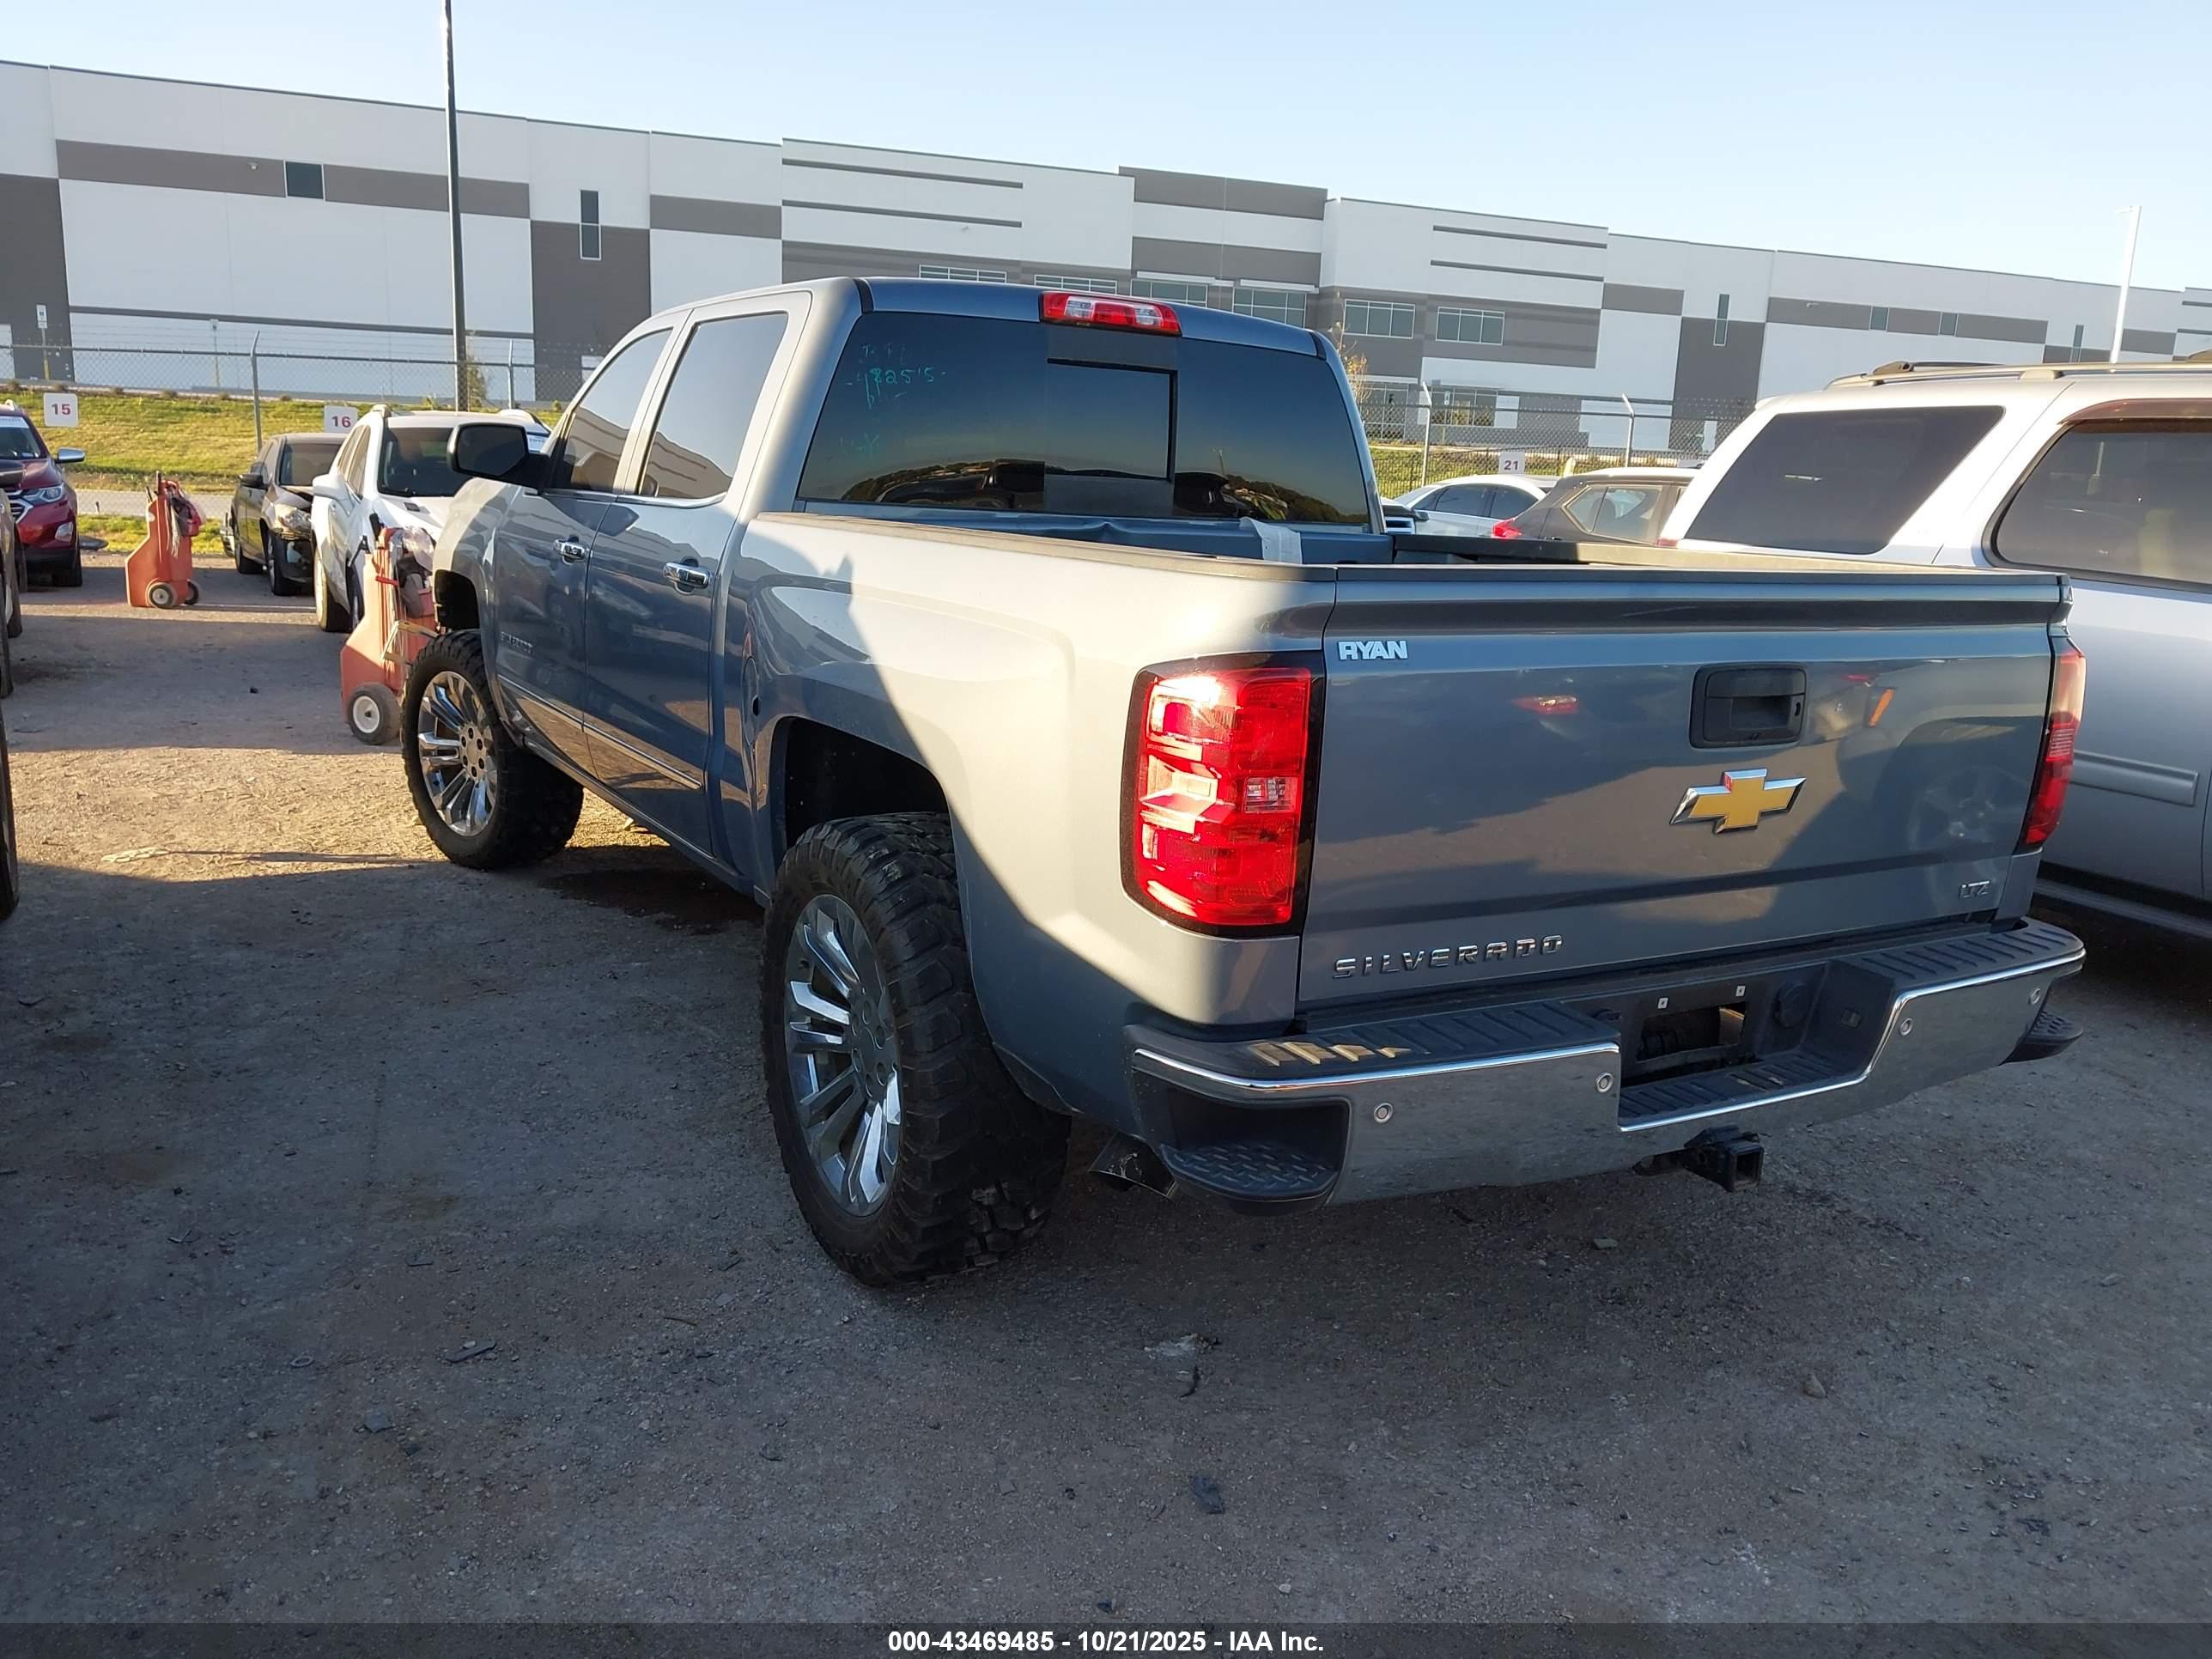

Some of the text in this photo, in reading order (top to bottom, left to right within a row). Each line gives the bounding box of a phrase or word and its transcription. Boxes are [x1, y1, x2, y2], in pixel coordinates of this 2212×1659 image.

[52, 404, 71, 415] 15
[331, 416, 351, 428] 16
[1504, 459, 1519, 471] 21
[1338, 641, 1408, 660] RYAN
[1960, 880, 1990, 898] LTZ
[1333, 934, 1563, 979] SILVERADO
